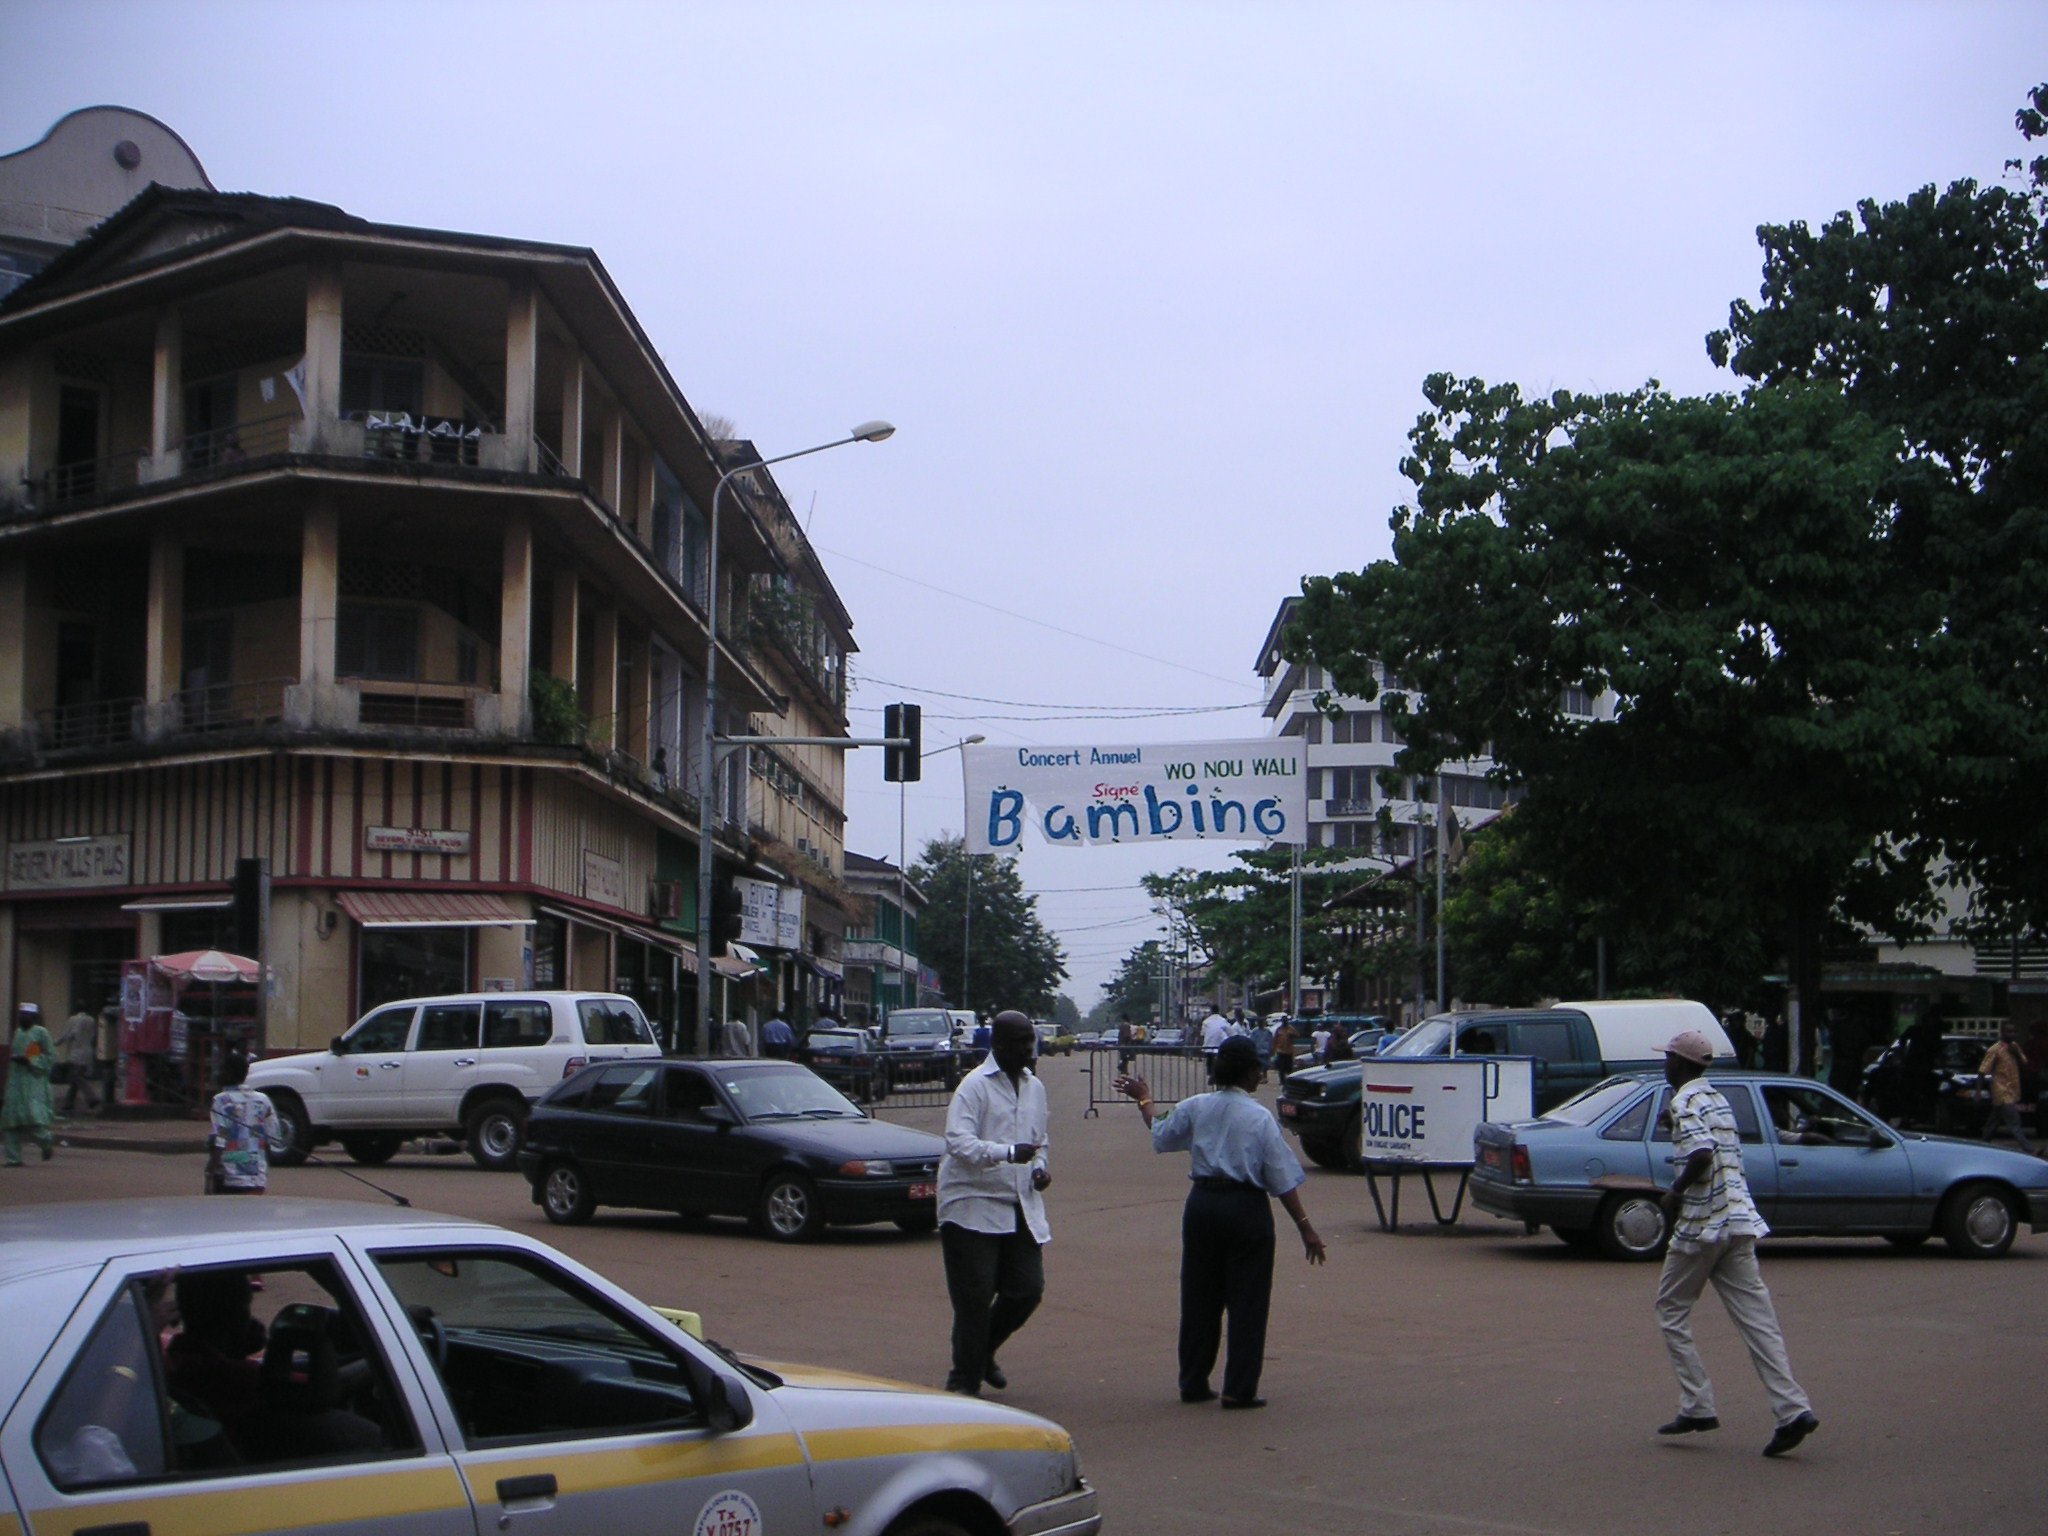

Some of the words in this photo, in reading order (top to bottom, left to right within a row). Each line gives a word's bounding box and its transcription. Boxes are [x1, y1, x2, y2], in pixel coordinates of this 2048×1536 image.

[1018, 747, 1081, 767] Concert
[1090, 747, 1142, 765] Annuel
[1164, 762, 1196, 780] WO
[1204, 759, 1243, 778] NOU
[1252, 757, 1297, 777] WALI
[1092, 781, 1140, 800] Signé
[988, 783, 1286, 847] Bambino
[94, 844, 123, 877] PLUS
[1363, 1101, 1425, 1140] POLICE
